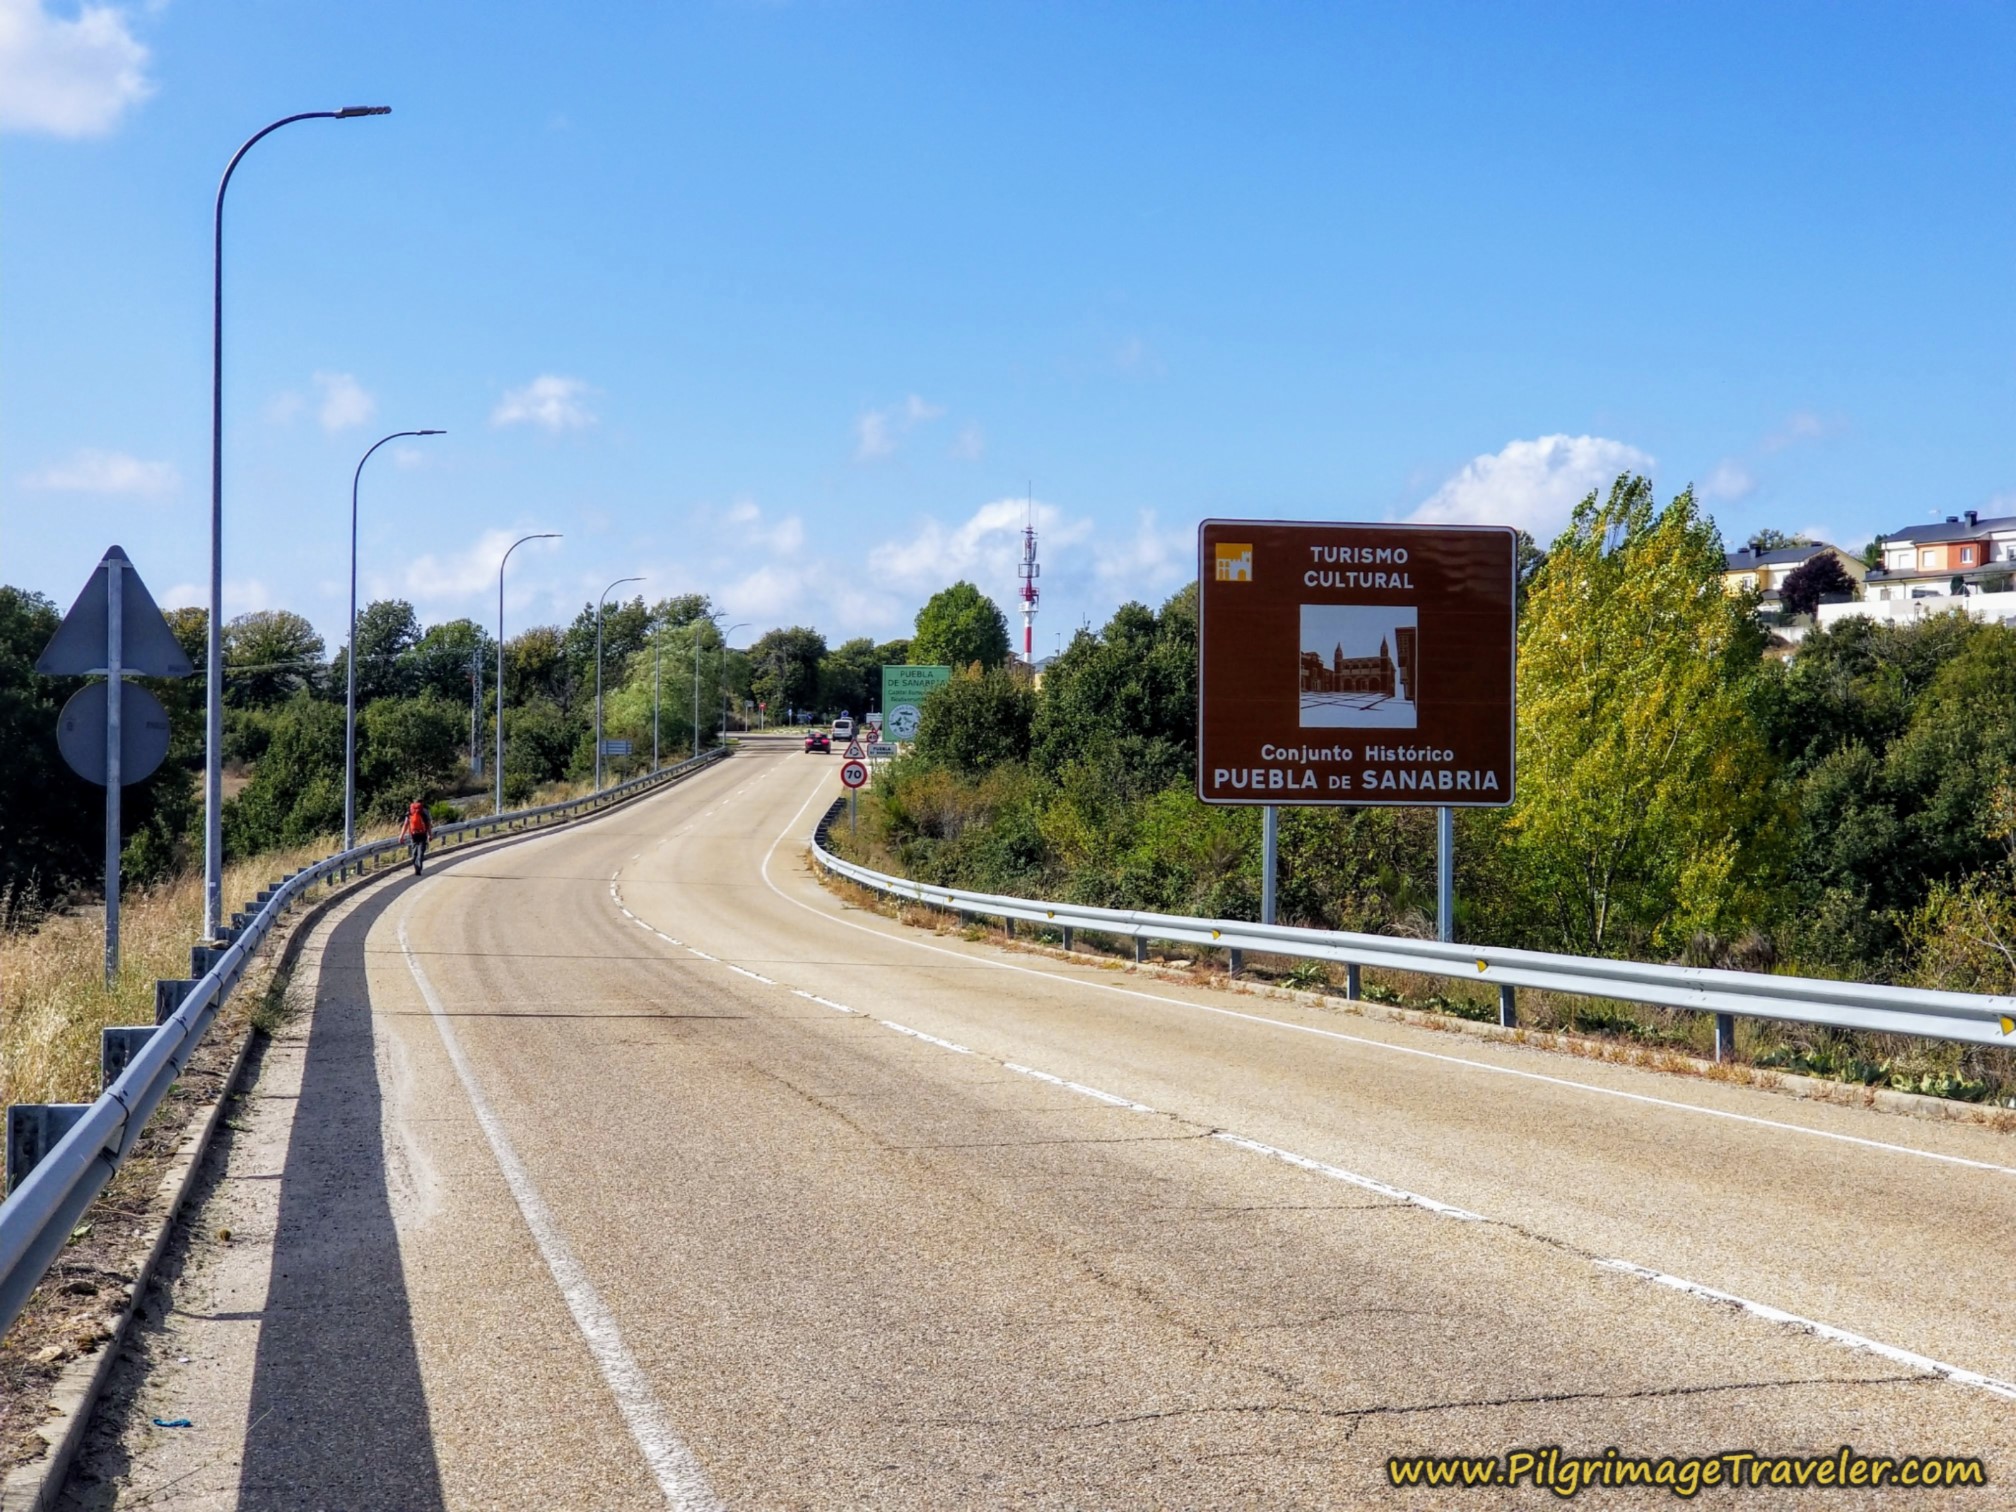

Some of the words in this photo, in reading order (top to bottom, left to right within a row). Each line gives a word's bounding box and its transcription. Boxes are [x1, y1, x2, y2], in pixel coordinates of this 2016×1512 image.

[1310, 546, 1409, 564] TURISMO
[1303, 570, 1414, 589] CULTURAL
[887, 679, 900, 687] DE
[900, 670, 934, 678] PUEBLA
[1261, 744, 1353, 764] Conjunto
[1365, 745, 1454, 762] Histórico
[846, 769, 862, 779] 70
[1214, 768, 1318, 789] PUEBLA
[1328, 775, 1351, 790] DE
[1361, 769, 1499, 791] SANABRIA
